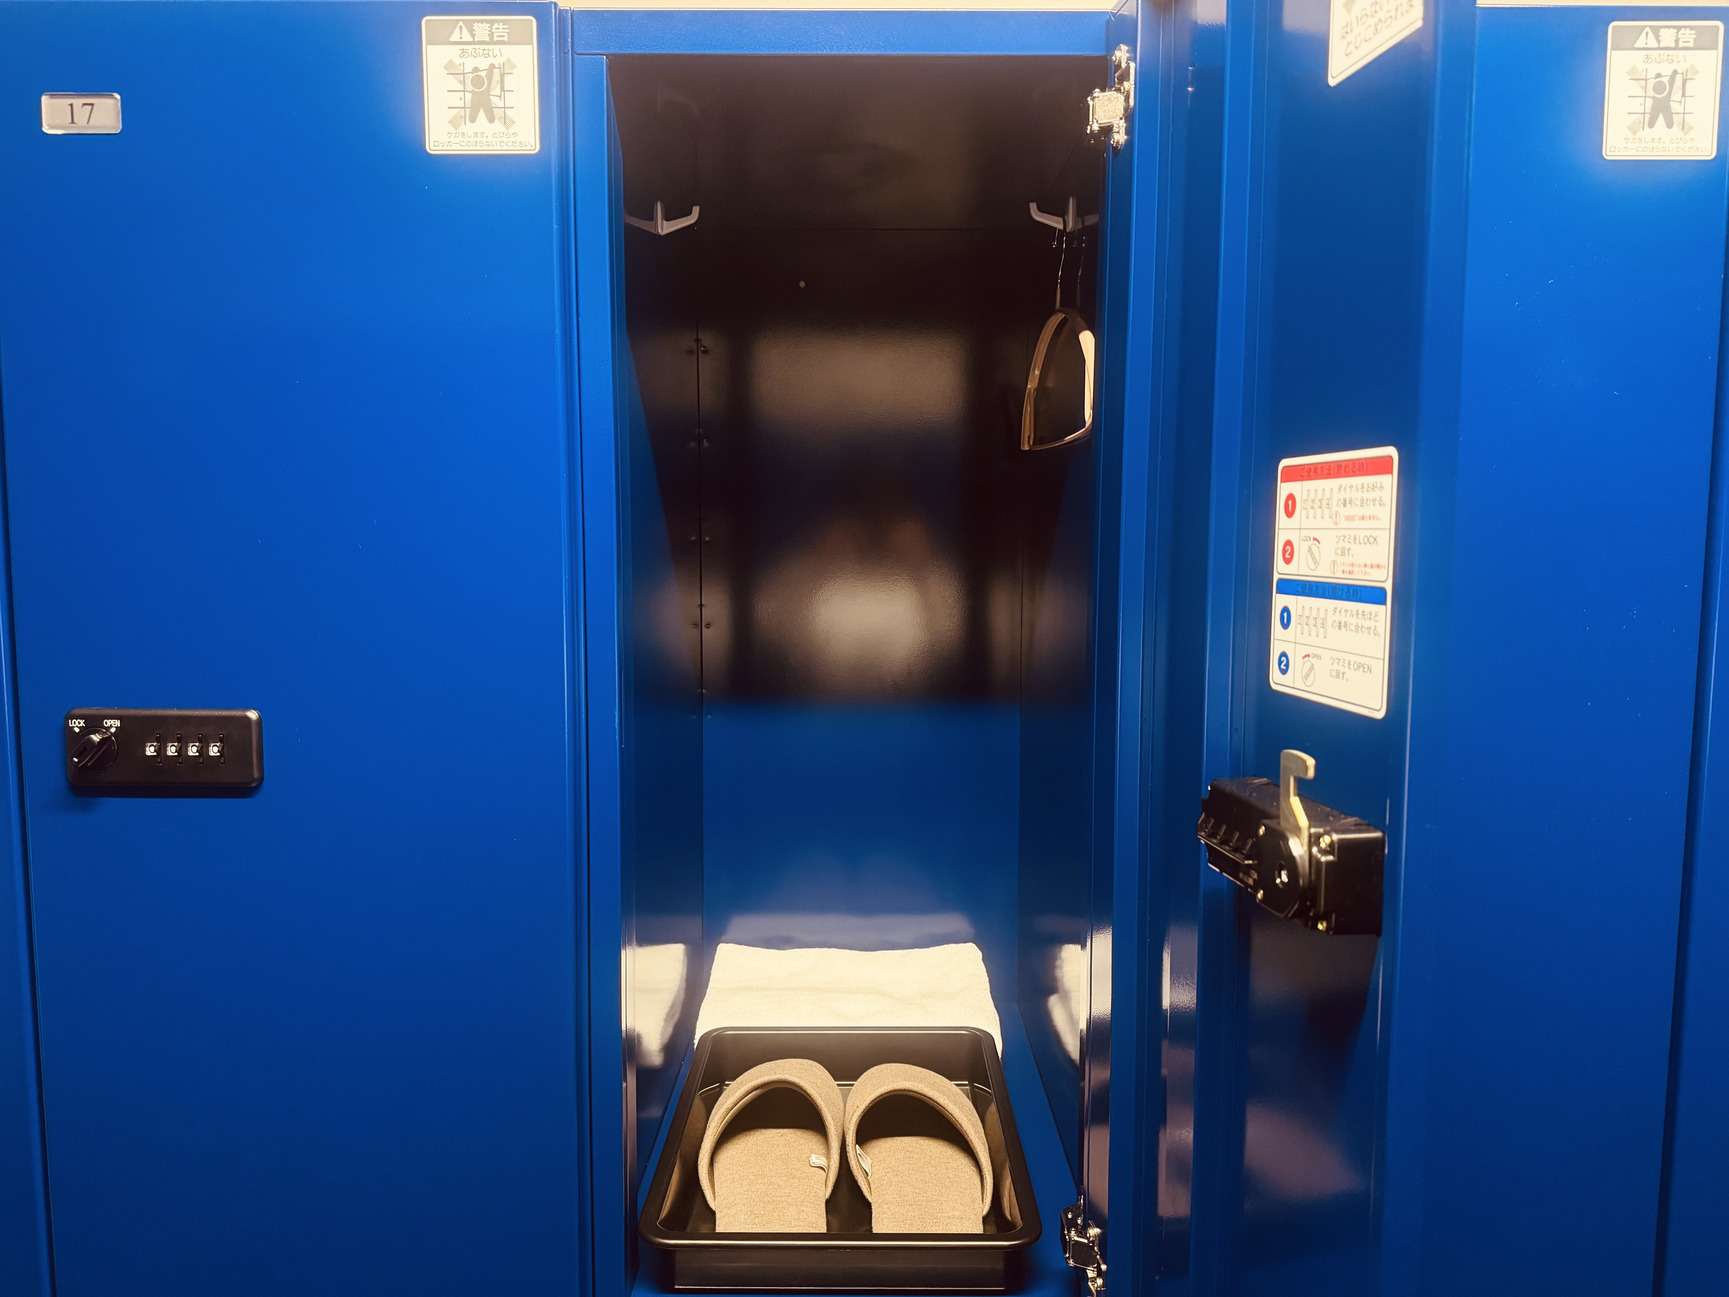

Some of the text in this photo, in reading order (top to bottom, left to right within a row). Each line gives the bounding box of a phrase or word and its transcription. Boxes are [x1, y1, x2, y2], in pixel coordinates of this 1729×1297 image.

[473, 22, 510, 42] 警告
[1659, 27, 1696, 48] 警告
[459, 47, 503, 59] あぶない
[1642, 53, 1687, 64] あぶない
[67, 102, 95, 125] 17
[1287, 499, 1292, 512] 1
[1335, 534, 1379, 545] ツマミをLOCK
[1285, 545, 1291, 558] 2
[1284, 611, 1288, 624] 1
[1280, 656, 1287, 669] 2
[1330, 657, 1373, 674] ツマミをOPEN
[68, 719, 86, 727] LOCK
[103, 719, 121, 727] OPEN
